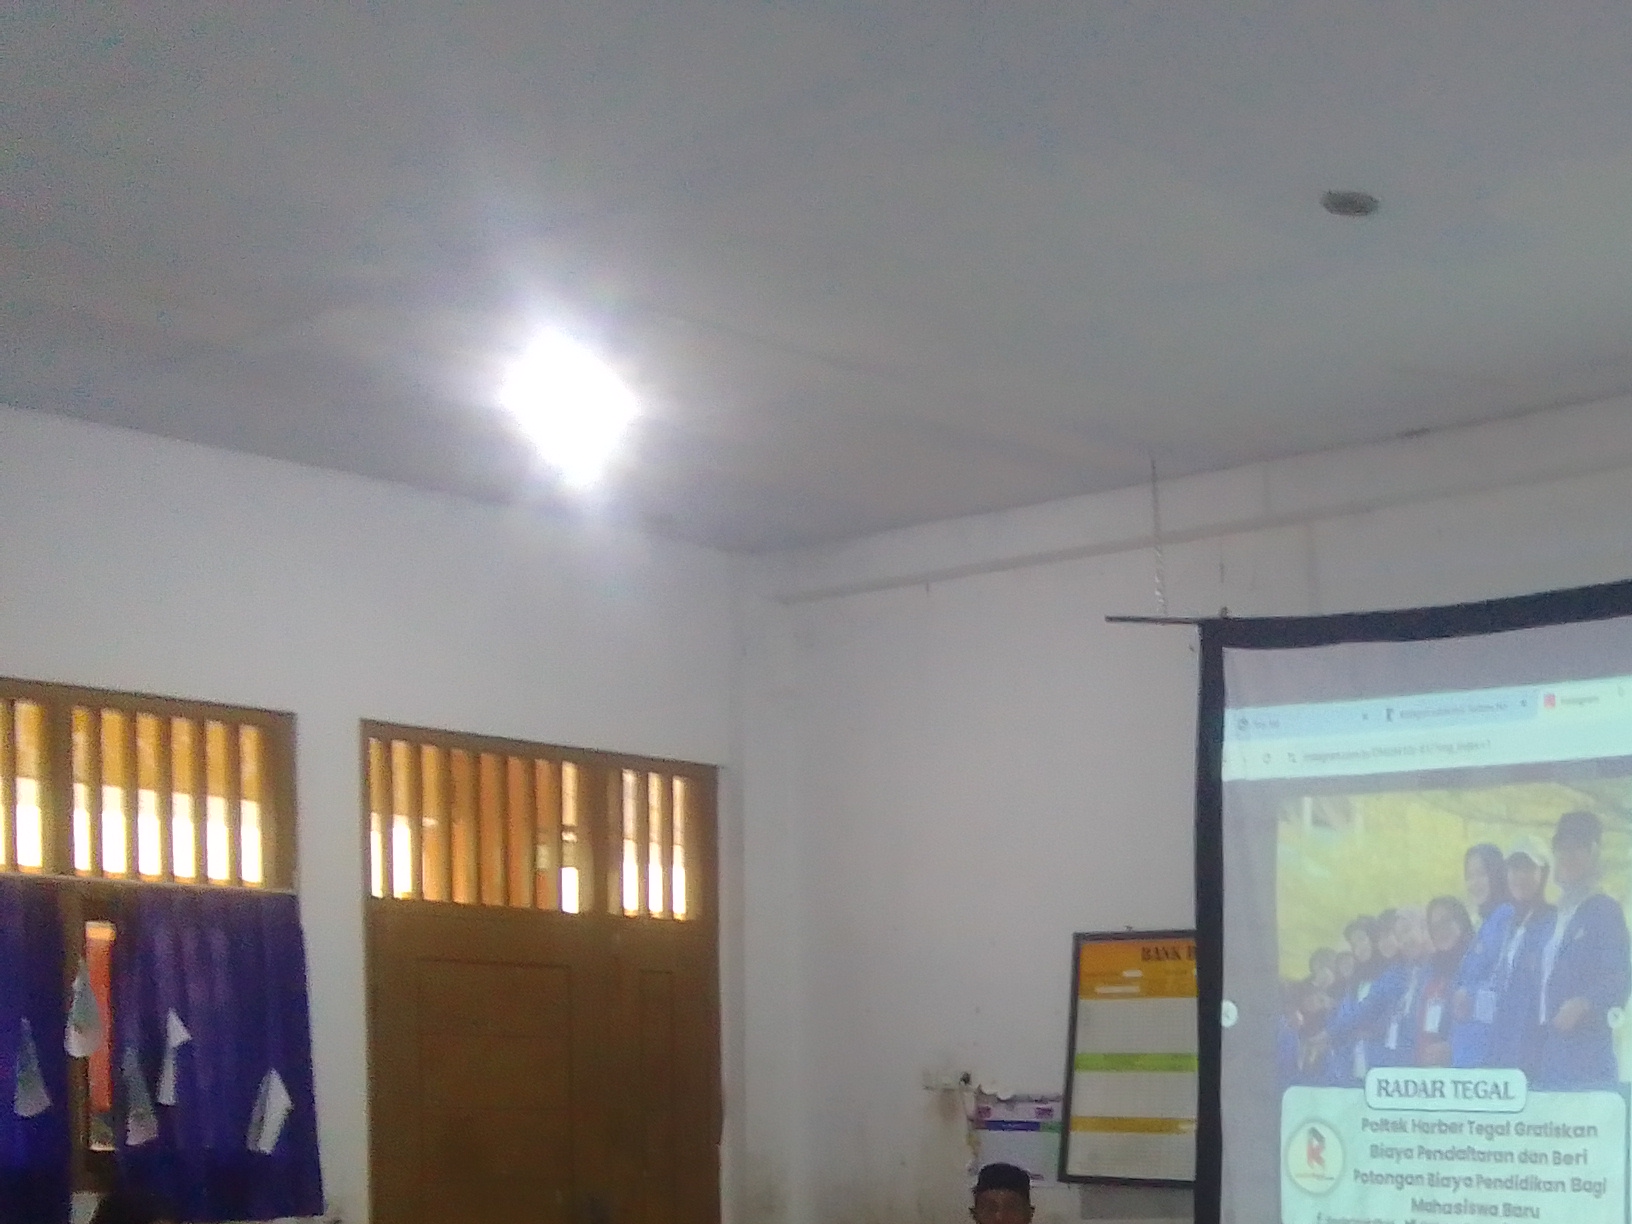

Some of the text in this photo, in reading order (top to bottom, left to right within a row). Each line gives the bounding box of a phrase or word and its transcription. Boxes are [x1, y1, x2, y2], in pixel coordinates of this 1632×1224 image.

[1141, 946, 1181, 962] BANK
[1376, 1079, 1515, 1100] RADAR TEGAL
[1361, 1117, 1598, 1140] Poltek Harber Tegal Gratiskan
[1370, 1143, 1588, 1165] Biaya Pendaftaran dan Beri
[1353, 1168, 1607, 1198] Potongan Biaya Pendidikan Bagi
[1411, 1197, 1540, 1219] Mahasiswa Baru
